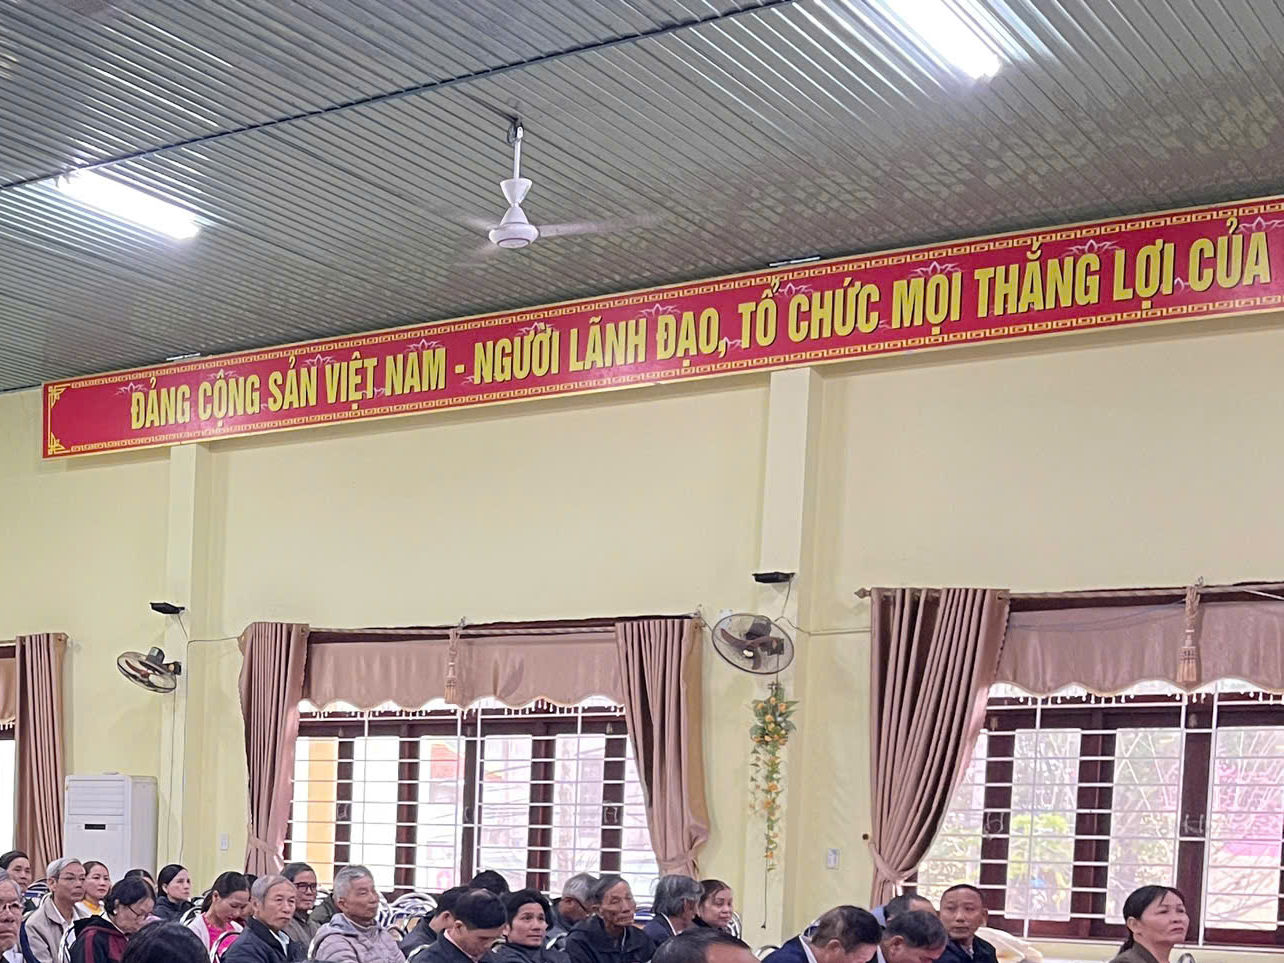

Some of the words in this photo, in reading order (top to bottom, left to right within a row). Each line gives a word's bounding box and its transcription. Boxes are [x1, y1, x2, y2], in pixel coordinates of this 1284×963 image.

[130, 377, 191, 430] ĐẢNG
[197, 369, 261, 428] CỘNG
[267, 355, 318, 411] SẢN
[324, 352, 377, 410] VIỆT
[383, 348, 447, 394] NAM
[454, 366, 466, 374] -
[473, 322, 561, 384] NGƯỜI
[568, 316, 648, 372] LÃNH
[656, 306, 729, 367] ĐẠO,
[736, 276, 778, 349] TỔ
[786, 277, 880, 341] CHỨC
[890, 271, 964, 335] MỌI
[974, 236, 1101, 318] THẮNG
[1112, 239, 1176, 310] LỢI
[1187, 217, 1273, 291] CỦA
